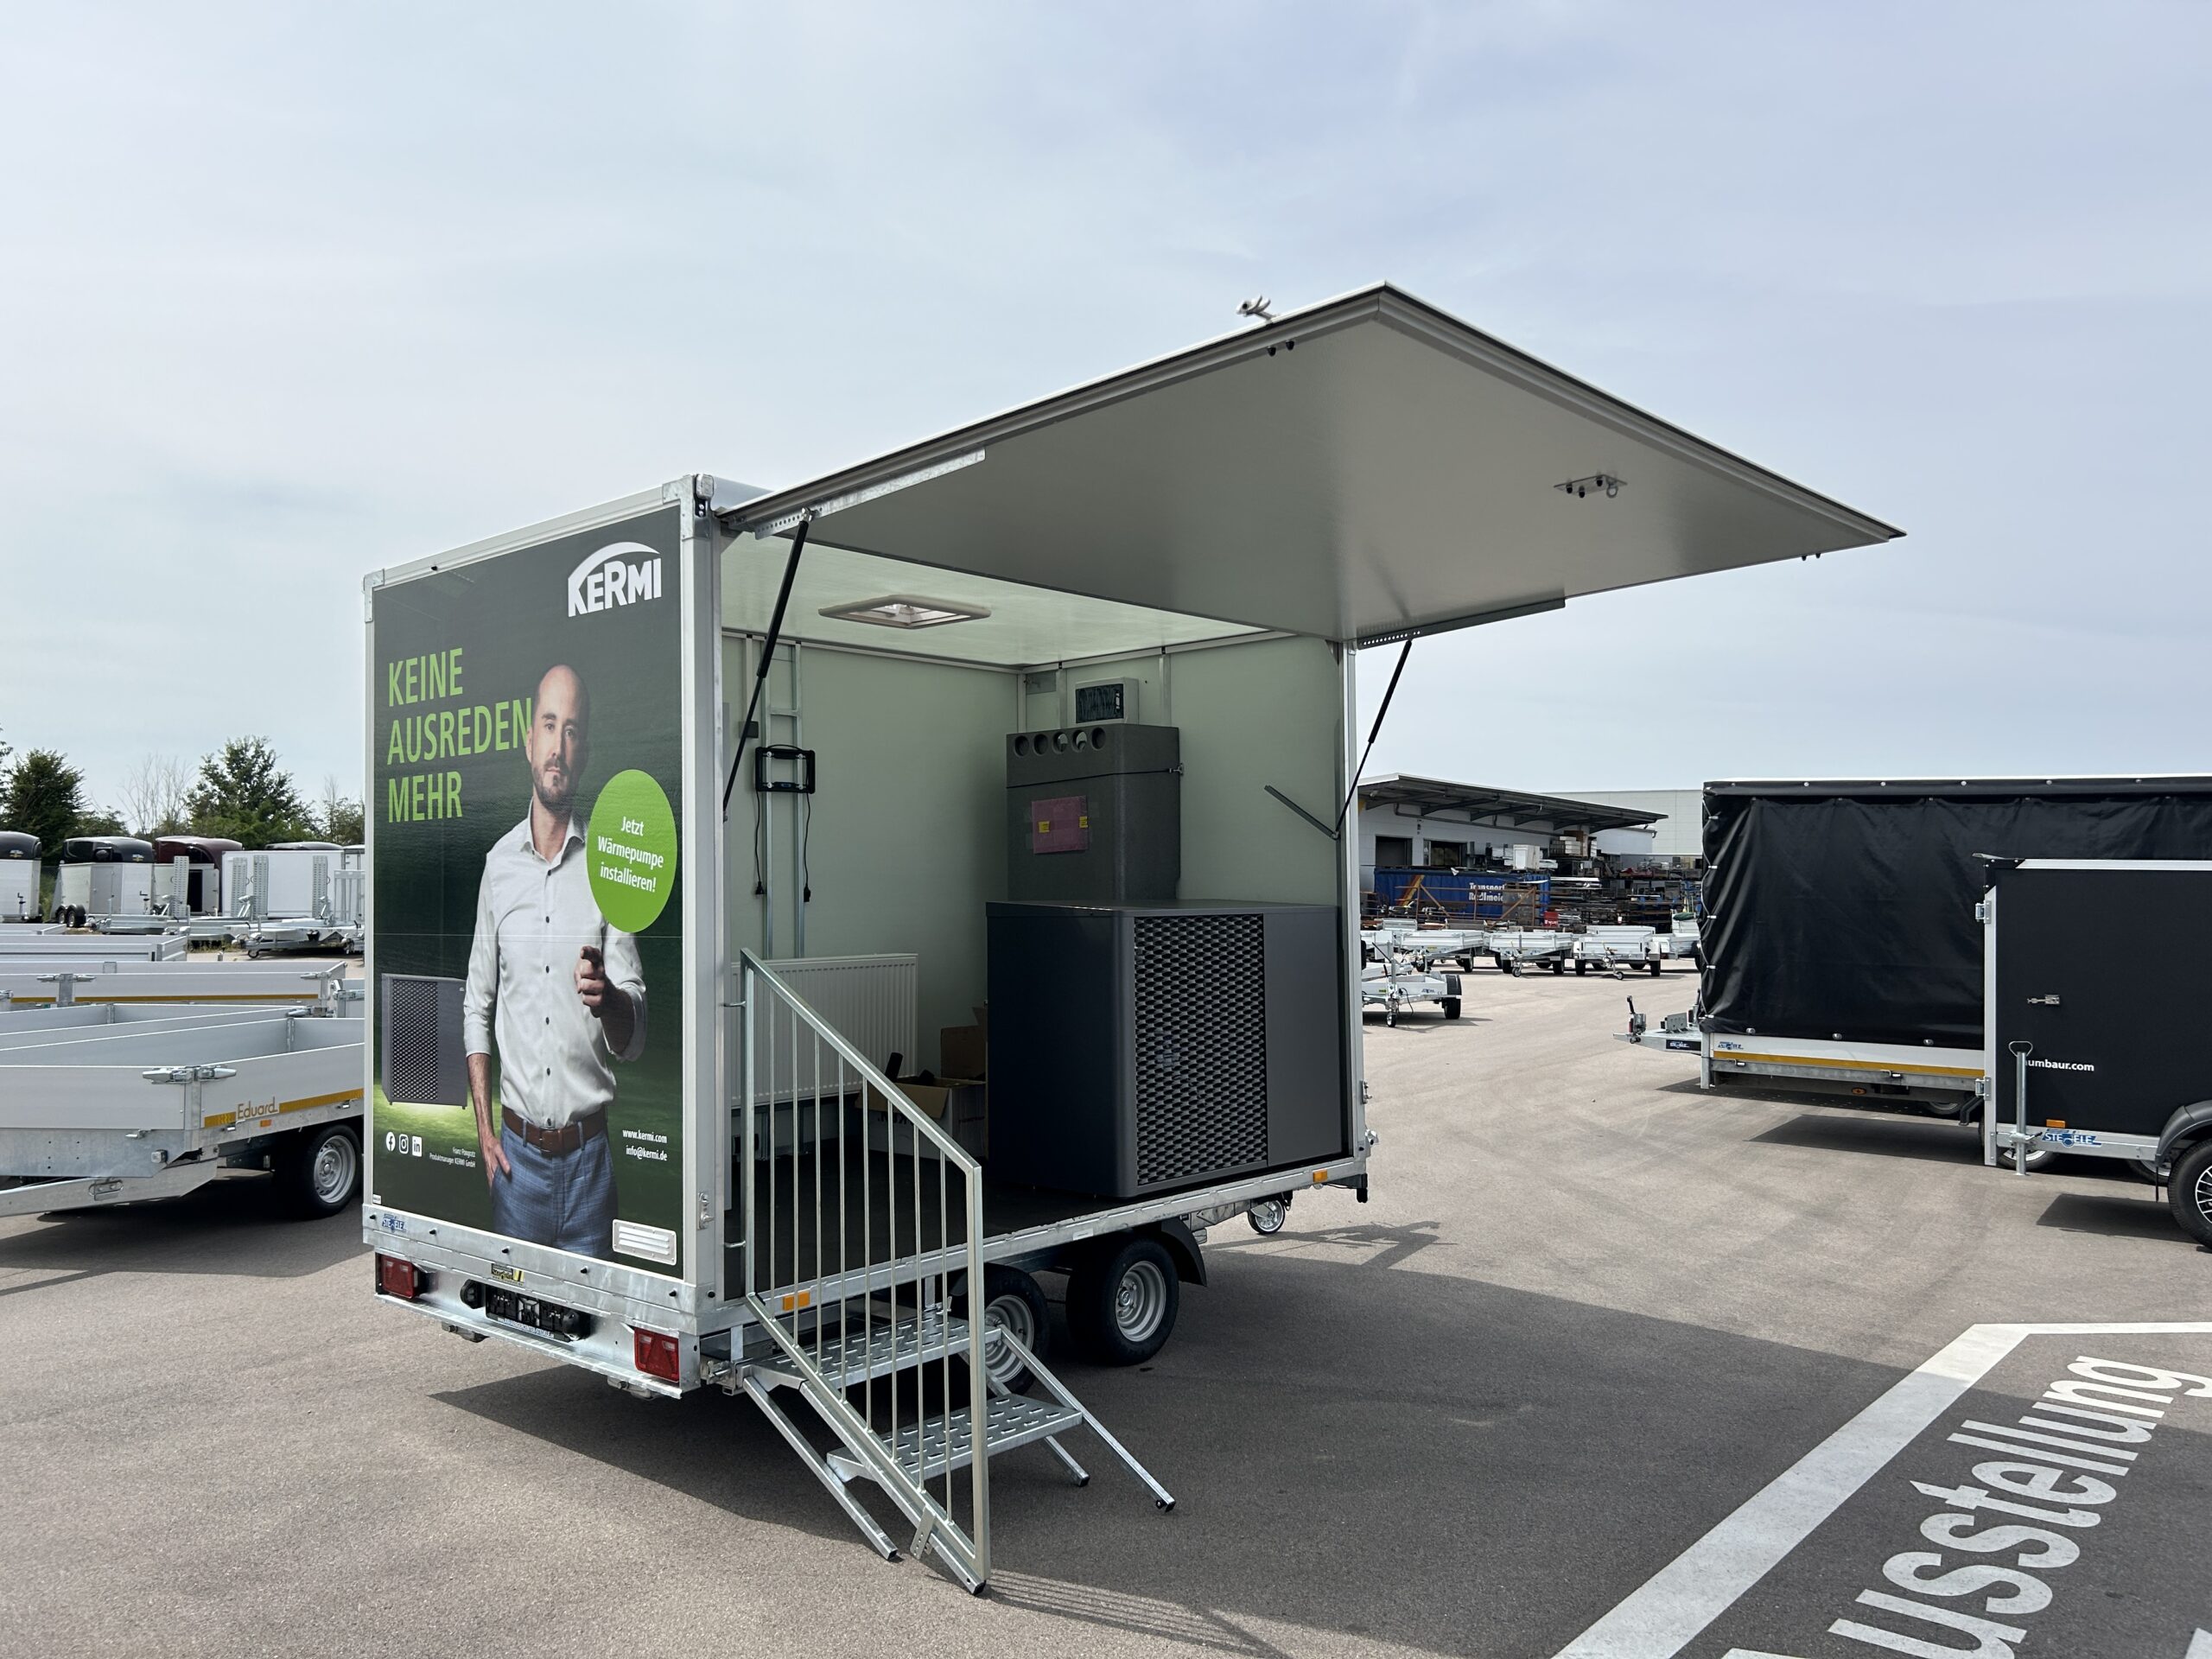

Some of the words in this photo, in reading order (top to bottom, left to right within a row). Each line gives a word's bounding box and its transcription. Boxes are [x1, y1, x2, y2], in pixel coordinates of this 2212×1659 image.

[568, 542, 662, 617] KERMI
[389, 648, 463, 707] KEINE
[387, 697, 531, 765] AUSREDEN
[389, 772, 463, 823] MEHR
[621, 816, 645, 836] Jetzt
[598, 836, 664, 870] Wärmepumpe
[600, 861, 657, 893] installieren!
[237, 1096, 278, 1120] Eduard
[622, 1129, 668, 1144] www.kermi.com
[626, 1145, 668, 1161] info@kermi.de
[1719, 1356, 2212, 1659] usstellung
